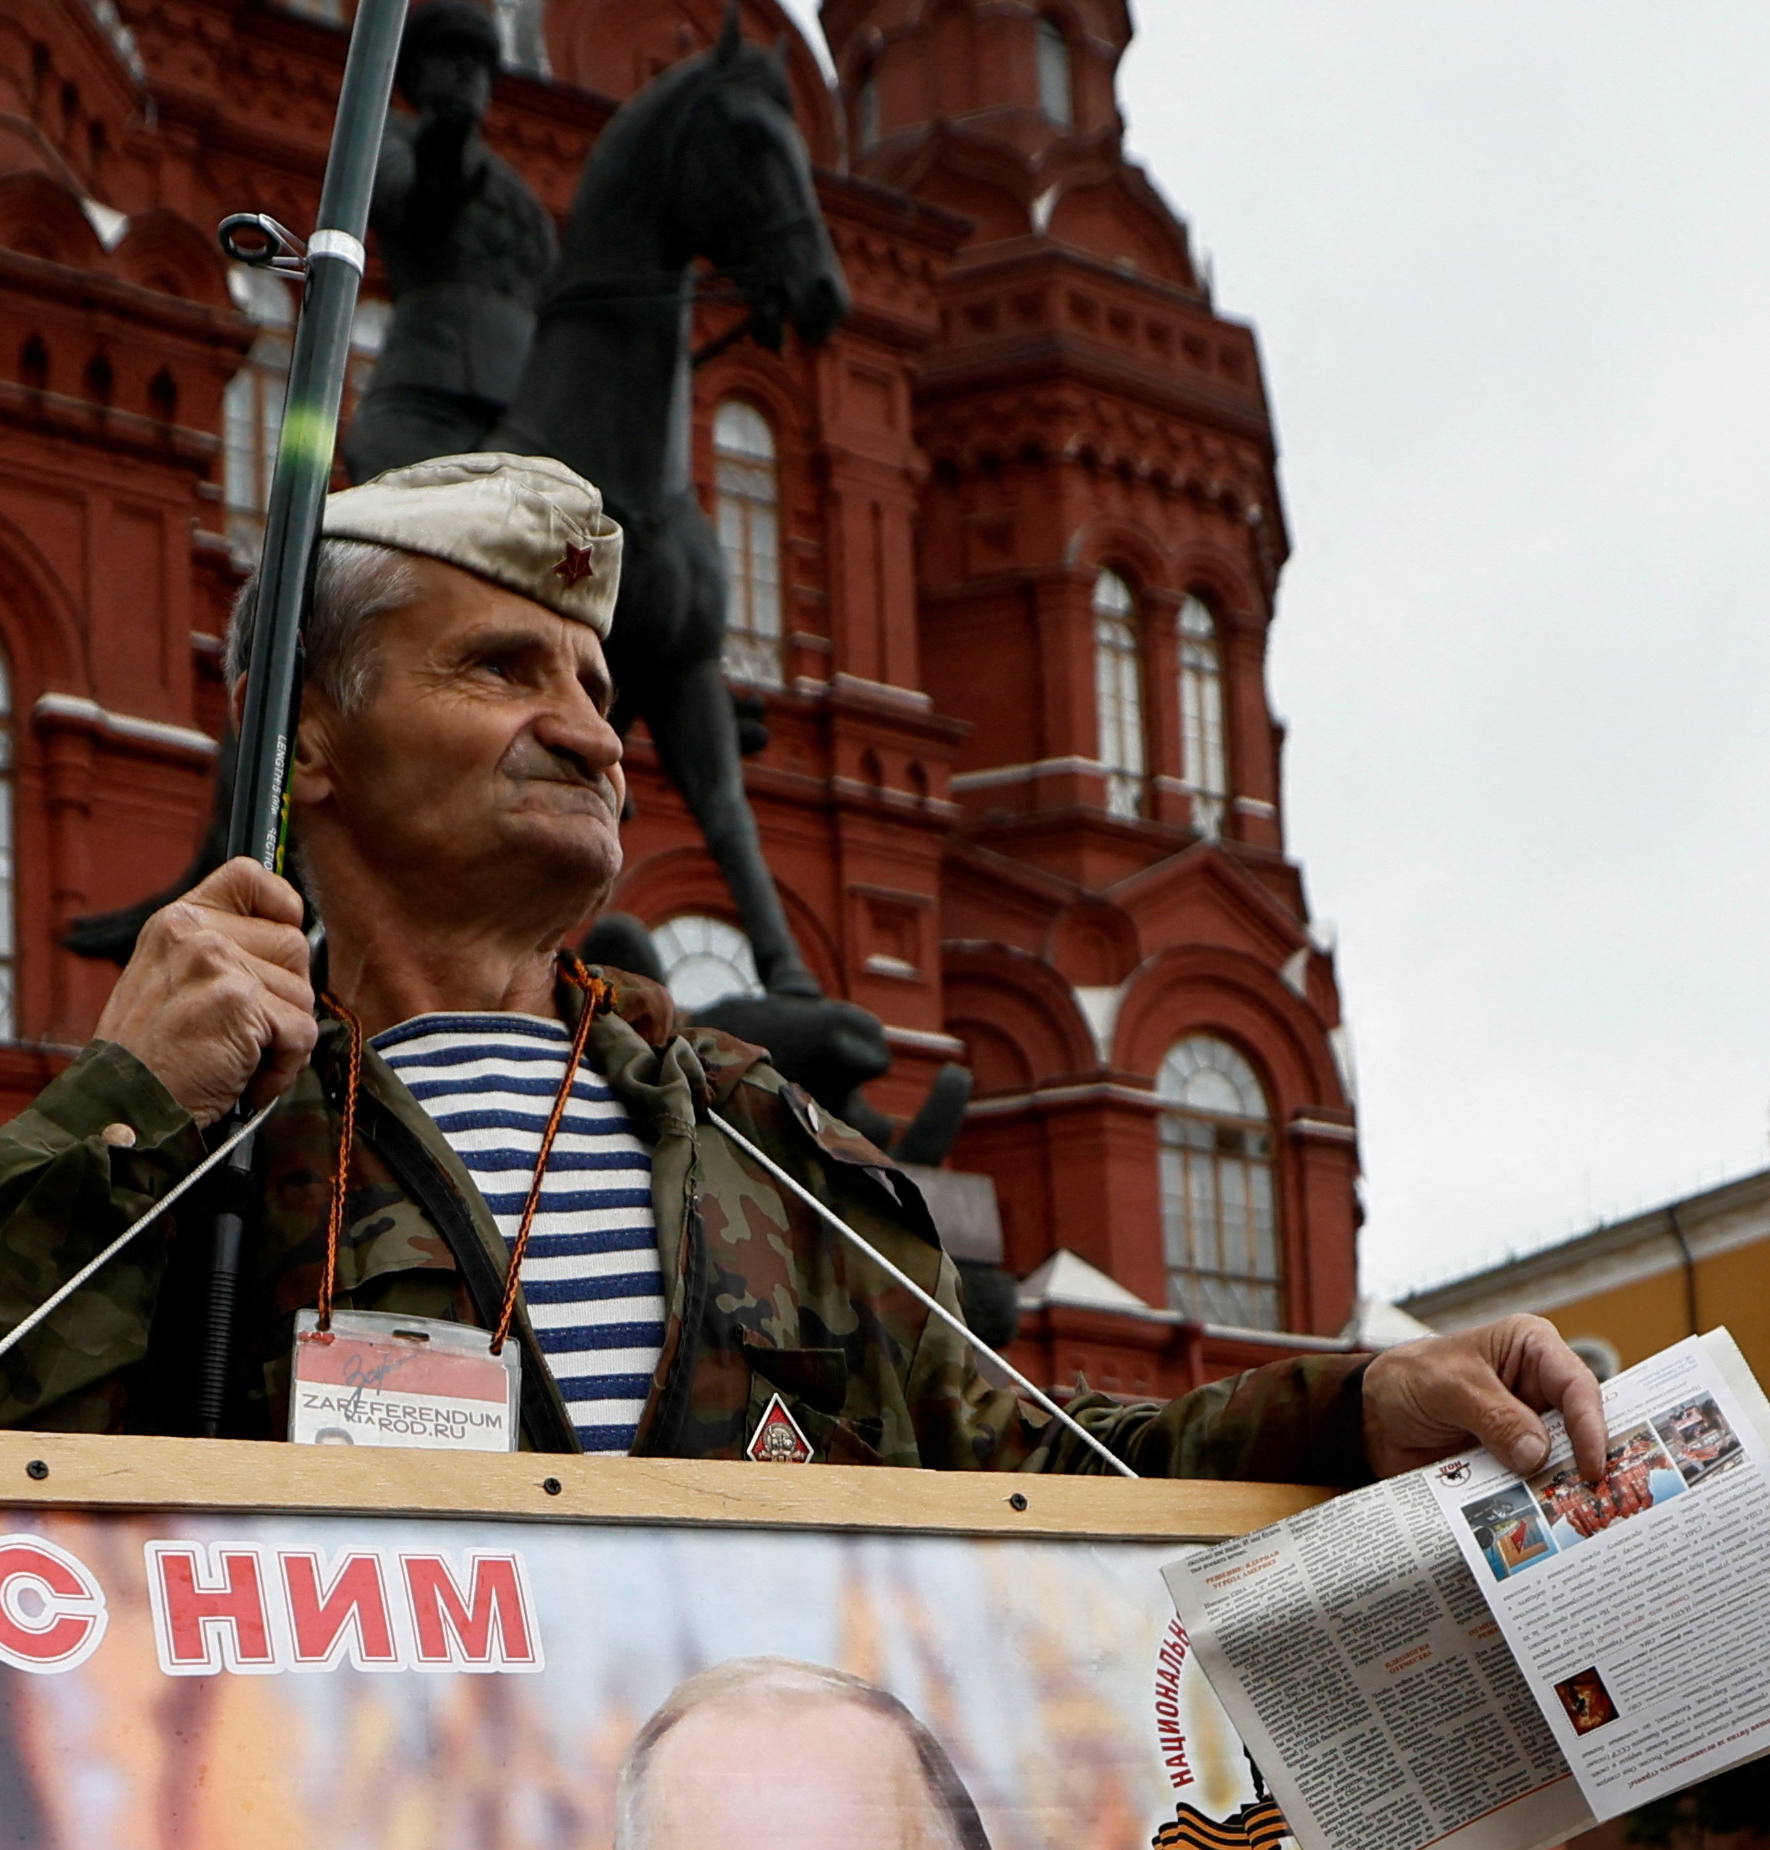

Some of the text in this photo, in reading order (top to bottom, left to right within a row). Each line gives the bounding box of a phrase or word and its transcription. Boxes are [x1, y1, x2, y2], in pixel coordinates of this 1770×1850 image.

[303, 1393, 502, 1429] ZAREFERENDUM
[143, 1539, 546, 1676] НИМ
[1155, 1611, 1195, 1789] НАЦИОНАЛЬН
